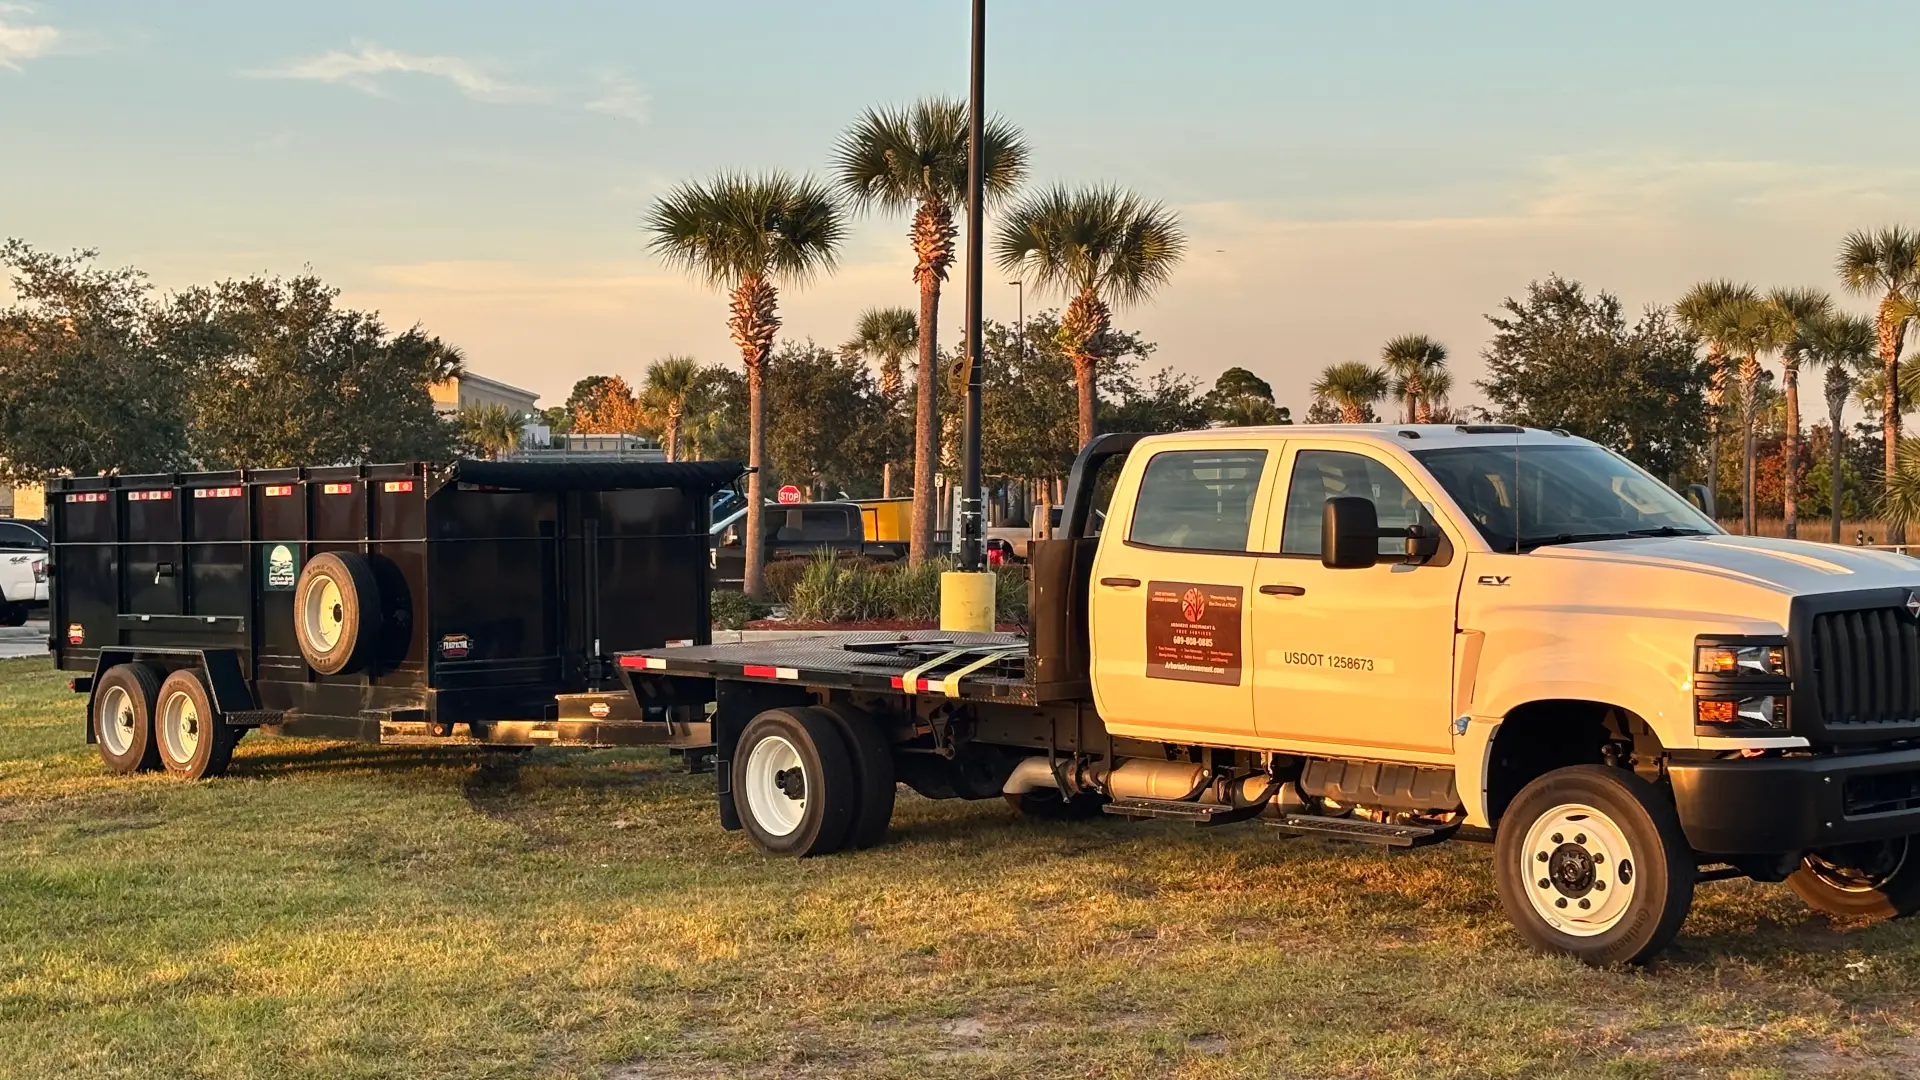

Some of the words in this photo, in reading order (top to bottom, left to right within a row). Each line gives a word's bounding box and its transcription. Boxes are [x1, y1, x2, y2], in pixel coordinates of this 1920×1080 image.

[780, 491, 799, 502] STOP
[1284, 651, 1324, 667] USDOT
[1327, 655, 1374, 672] 1258673
